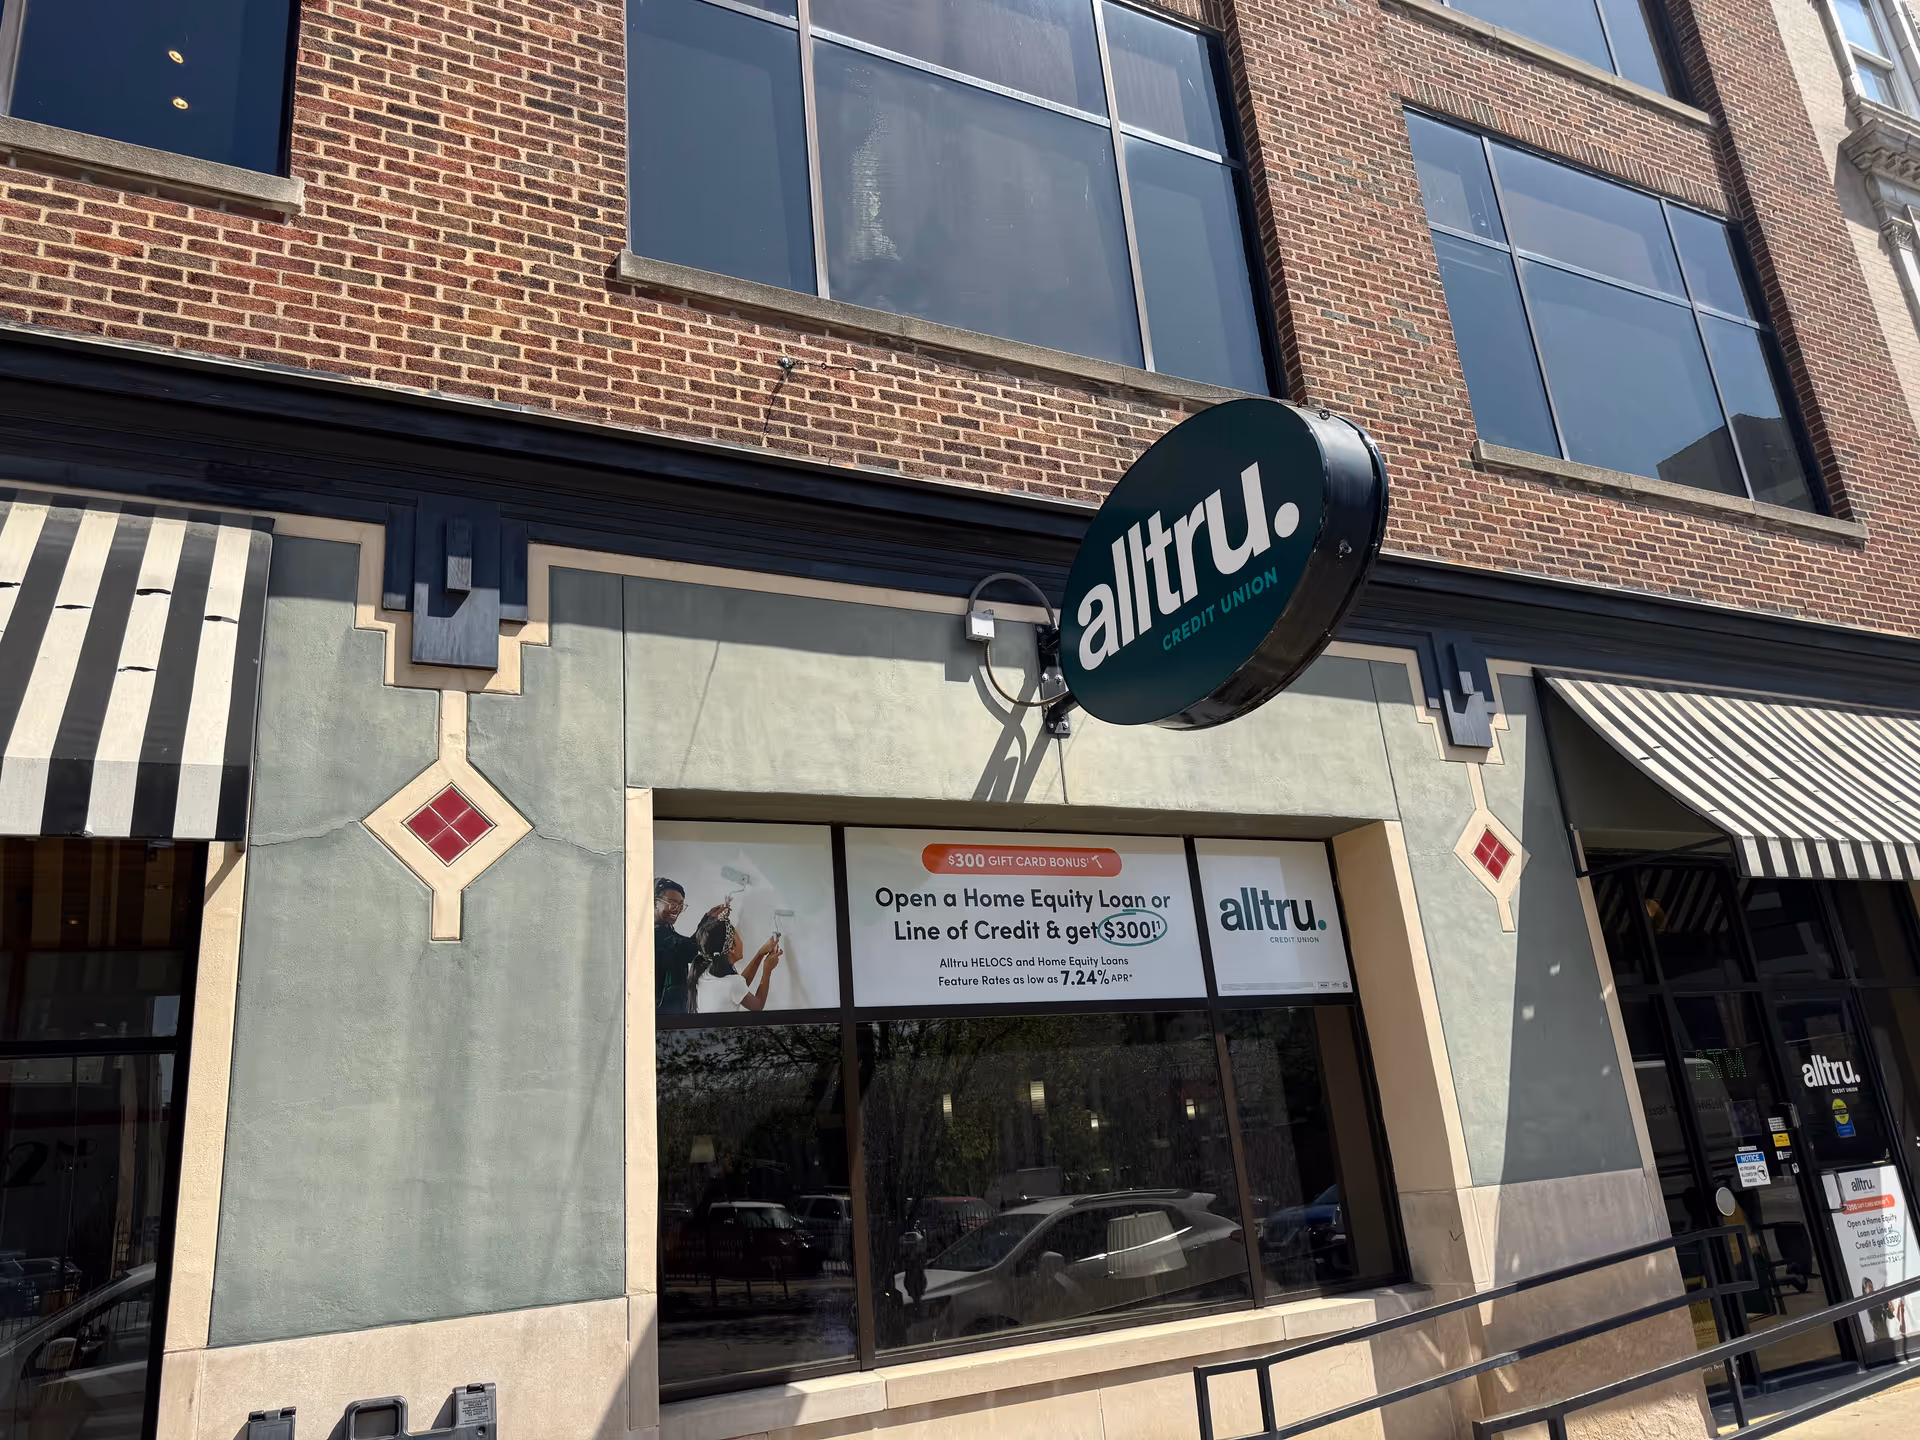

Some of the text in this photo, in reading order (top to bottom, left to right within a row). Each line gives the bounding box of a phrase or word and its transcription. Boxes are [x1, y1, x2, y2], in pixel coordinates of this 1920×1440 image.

[1077, 461, 1300, 671] alltru.
[1162, 566, 1279, 651] CREDIT UNION
[948, 852, 985, 869] $300
[988, 855, 1013, 867] GIFT
[1016, 855, 1047, 868] CARD
[875, 886, 1170, 912] Open a Home Equity Loan or
[1220, 887, 1327, 932] alltru.
[894, 920, 940, 941] Line
[946, 920, 969, 940] of
[974, 920, 1040, 940] Credit
[1046, 922, 1061, 940] &
[1066, 924, 1098, 944] get
[940, 956, 1128, 968] Alltru HELOCS and Home Equity Loans
[938, 976, 979, 986] Feature
[982, 974, 1010, 986] Rates
[1013, 977, 1024, 986] as
[1027, 974, 1044, 984] low
[1046, 976, 1058, 984] as
[1060, 969, 1110, 986] 7.24%
[1696, 1048, 1747, 1080] ATM
[1802, 1054, 1860, 1088] alltru.
[1740, 1154, 1760, 1163] NOTICE
[1846, 1220, 1862, 1230] Open
[1881, 1214, 1897, 1223] Equity
[1856, 1230, 1870, 1238] Loan
[1876, 1226, 1887, 1234] Line
[1855, 1240, 1871, 1250] Credit
[1872, 1238, 1877, 1247] &
[1877, 1238, 1886, 1247] get
